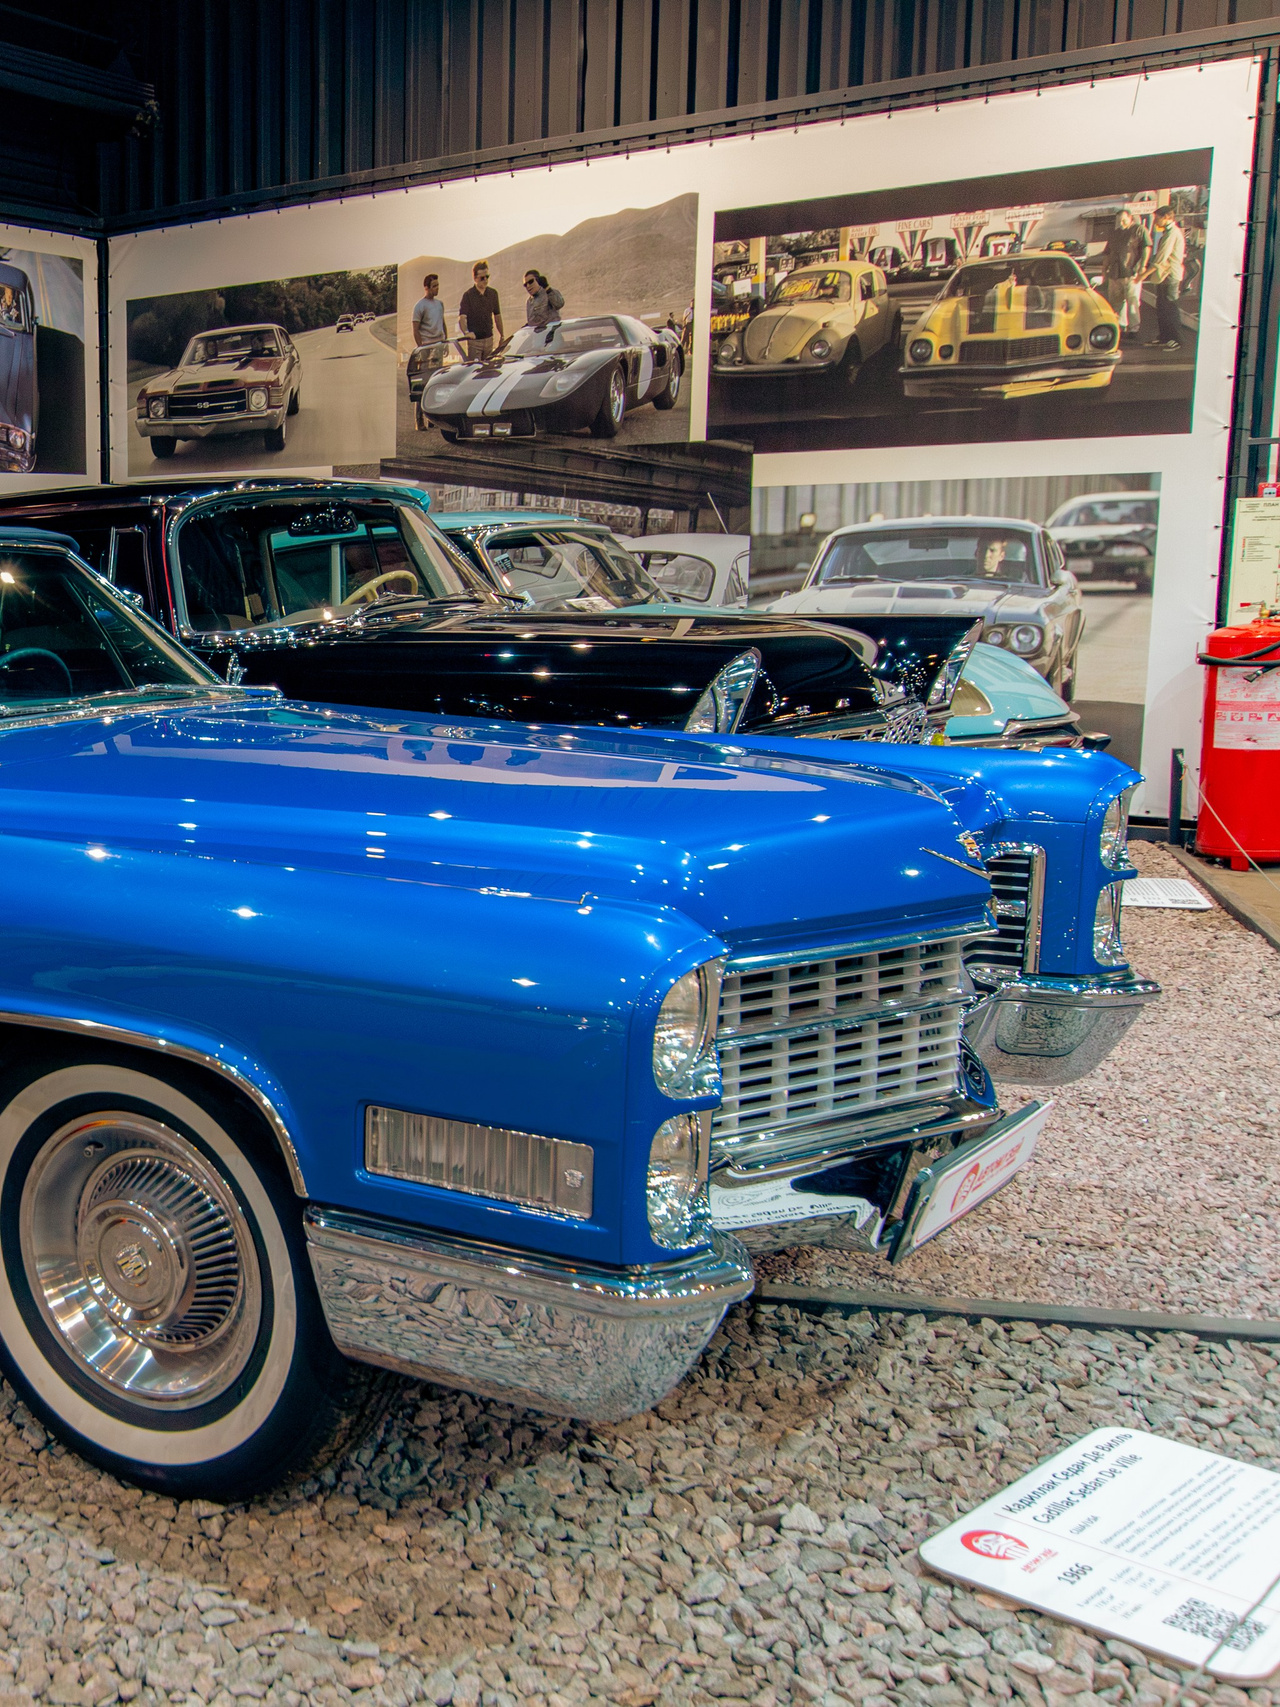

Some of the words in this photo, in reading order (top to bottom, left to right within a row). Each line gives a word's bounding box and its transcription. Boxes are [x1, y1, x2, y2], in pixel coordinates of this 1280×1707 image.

[898, 221, 912, 231] FINE
[913, 219, 931, 229] CARS
[929, 241, 944, 262] L
[1002, 1478, 1061, 1514] Кадиллак
[1052, 1460, 1090, 1481] Седан
[1082, 1450, 1105, 1464] Де
[1095, 1433, 1133, 1453] Вилль
[1033, 1495, 1080, 1524] Cadillac
[1069, 1477, 1108, 1499] Sedan
[1098, 1466, 1122, 1480] De
[1111, 1453, 1143, 1469] Ville
[1057, 1563, 1093, 1585] 1966
